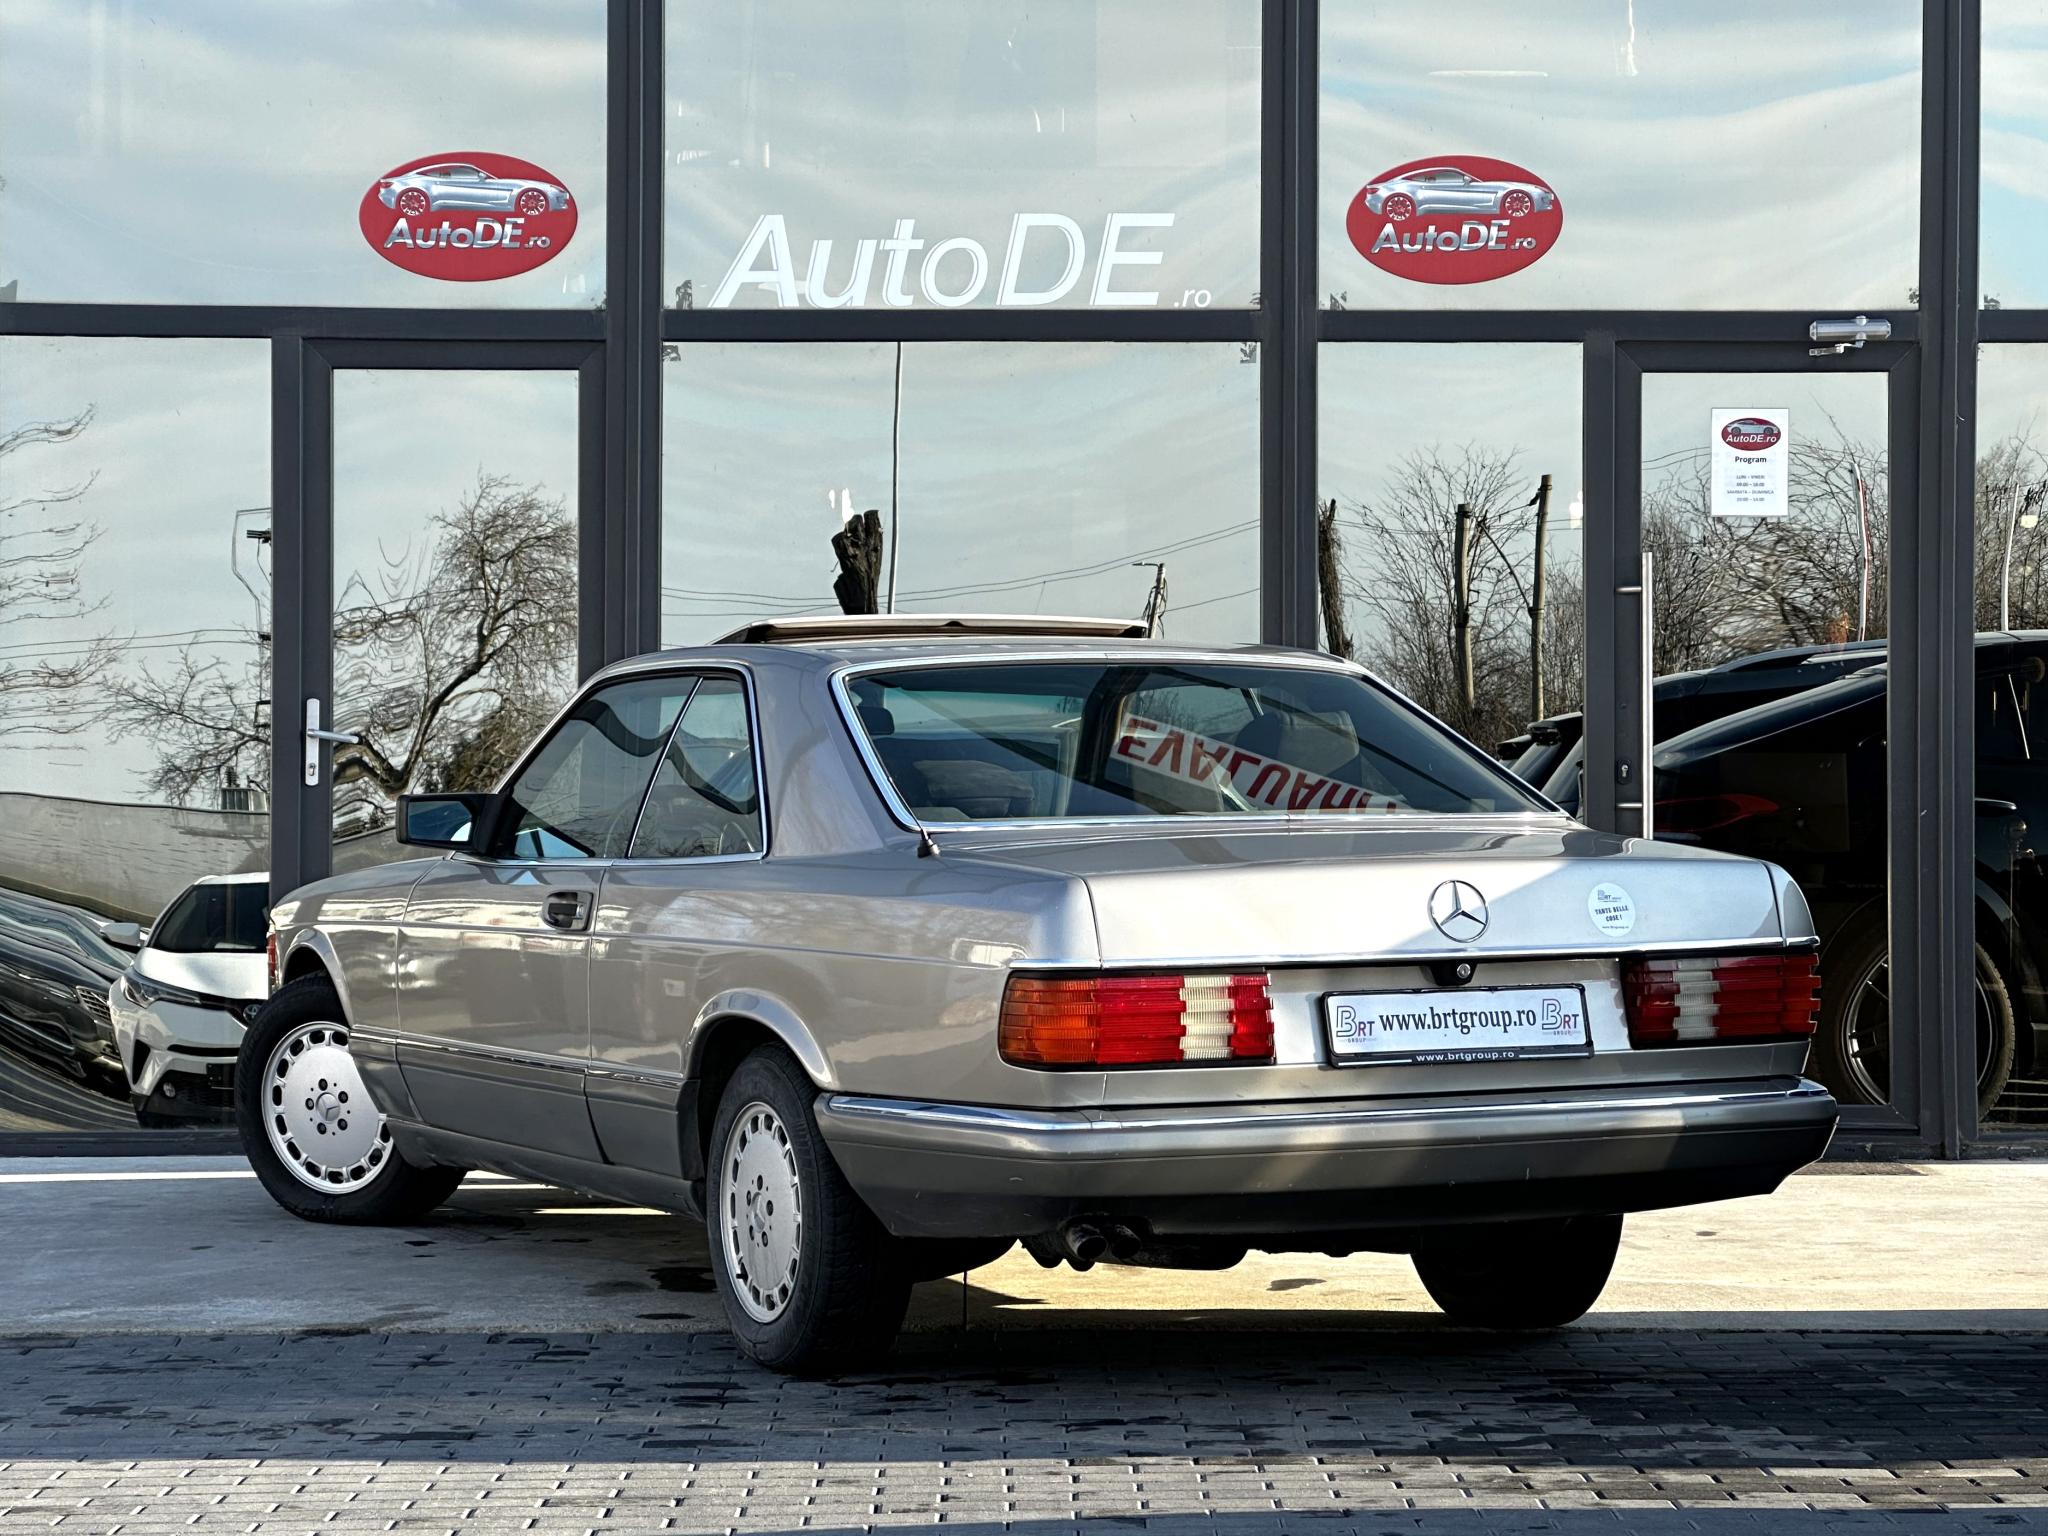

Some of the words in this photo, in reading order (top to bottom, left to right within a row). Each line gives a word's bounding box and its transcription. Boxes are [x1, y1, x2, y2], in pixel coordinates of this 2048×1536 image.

[1734, 456, 1767, 464] Program
[1336, 1005, 1375, 1037] BRT
[1378, 1006, 1537, 1035] www.brtgroup.ro
[1541, 998, 1580, 1030] BRT
[1416, 1051, 1515, 1062] www.brtgroup.ro
